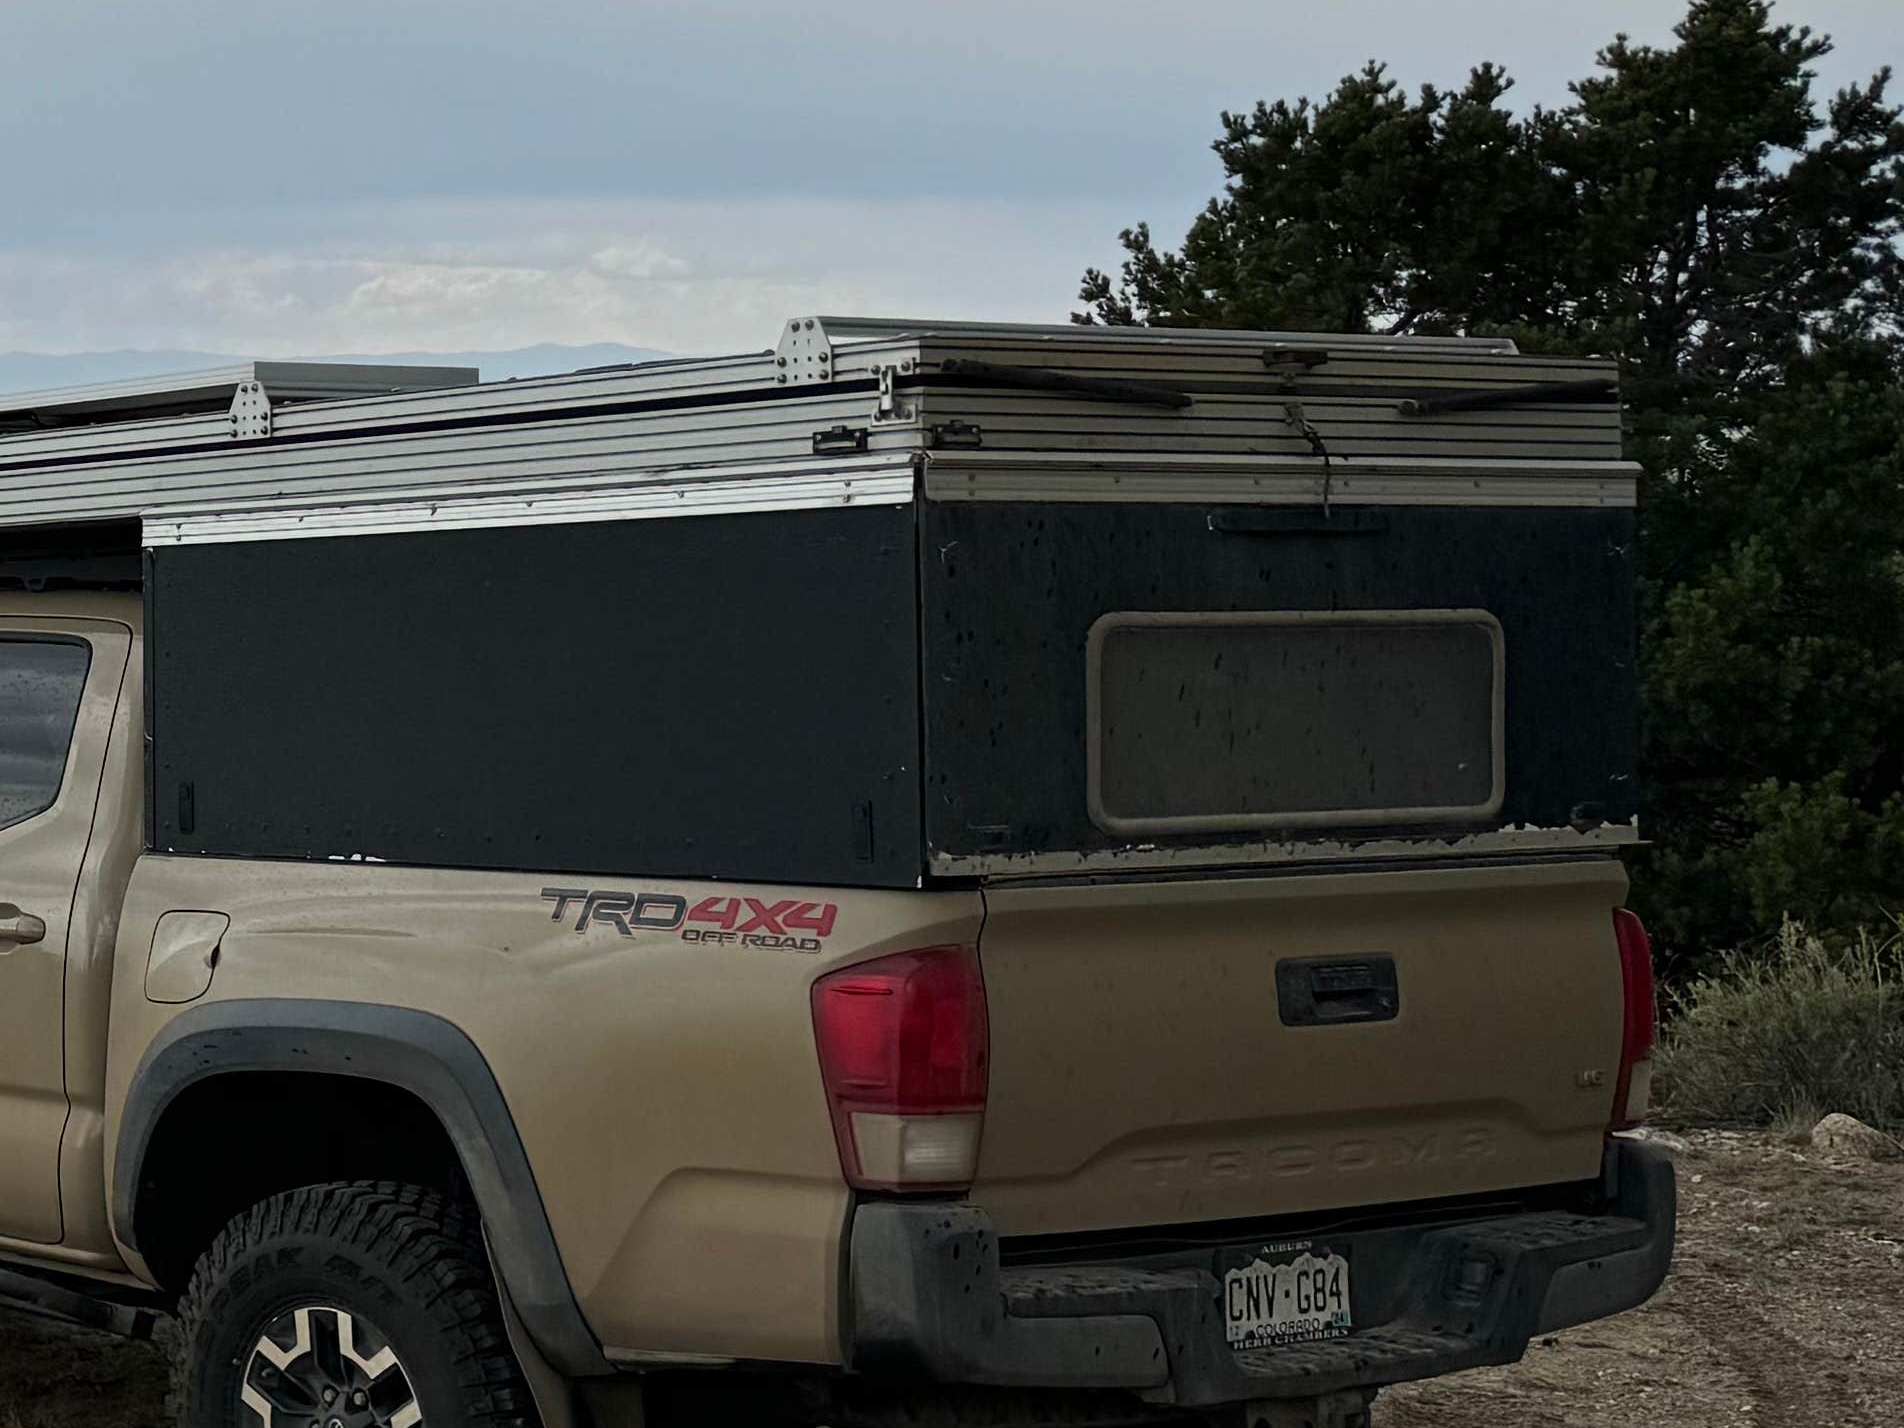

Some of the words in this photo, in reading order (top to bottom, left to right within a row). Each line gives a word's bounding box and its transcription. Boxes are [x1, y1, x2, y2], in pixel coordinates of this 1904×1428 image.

[540, 886, 689, 940] TRD
[681, 928, 737, 947] OFF
[740, 932, 822, 954] ROAD
[1129, 1125, 1497, 1189] TACOMA
[1261, 1241, 1313, 1254] AUBURN
[1256, 1317, 1321, 1337] COLORADO
[1233, 1337, 1271, 1350] HERB
[1274, 1329, 1348, 1345] CHAMBERS
